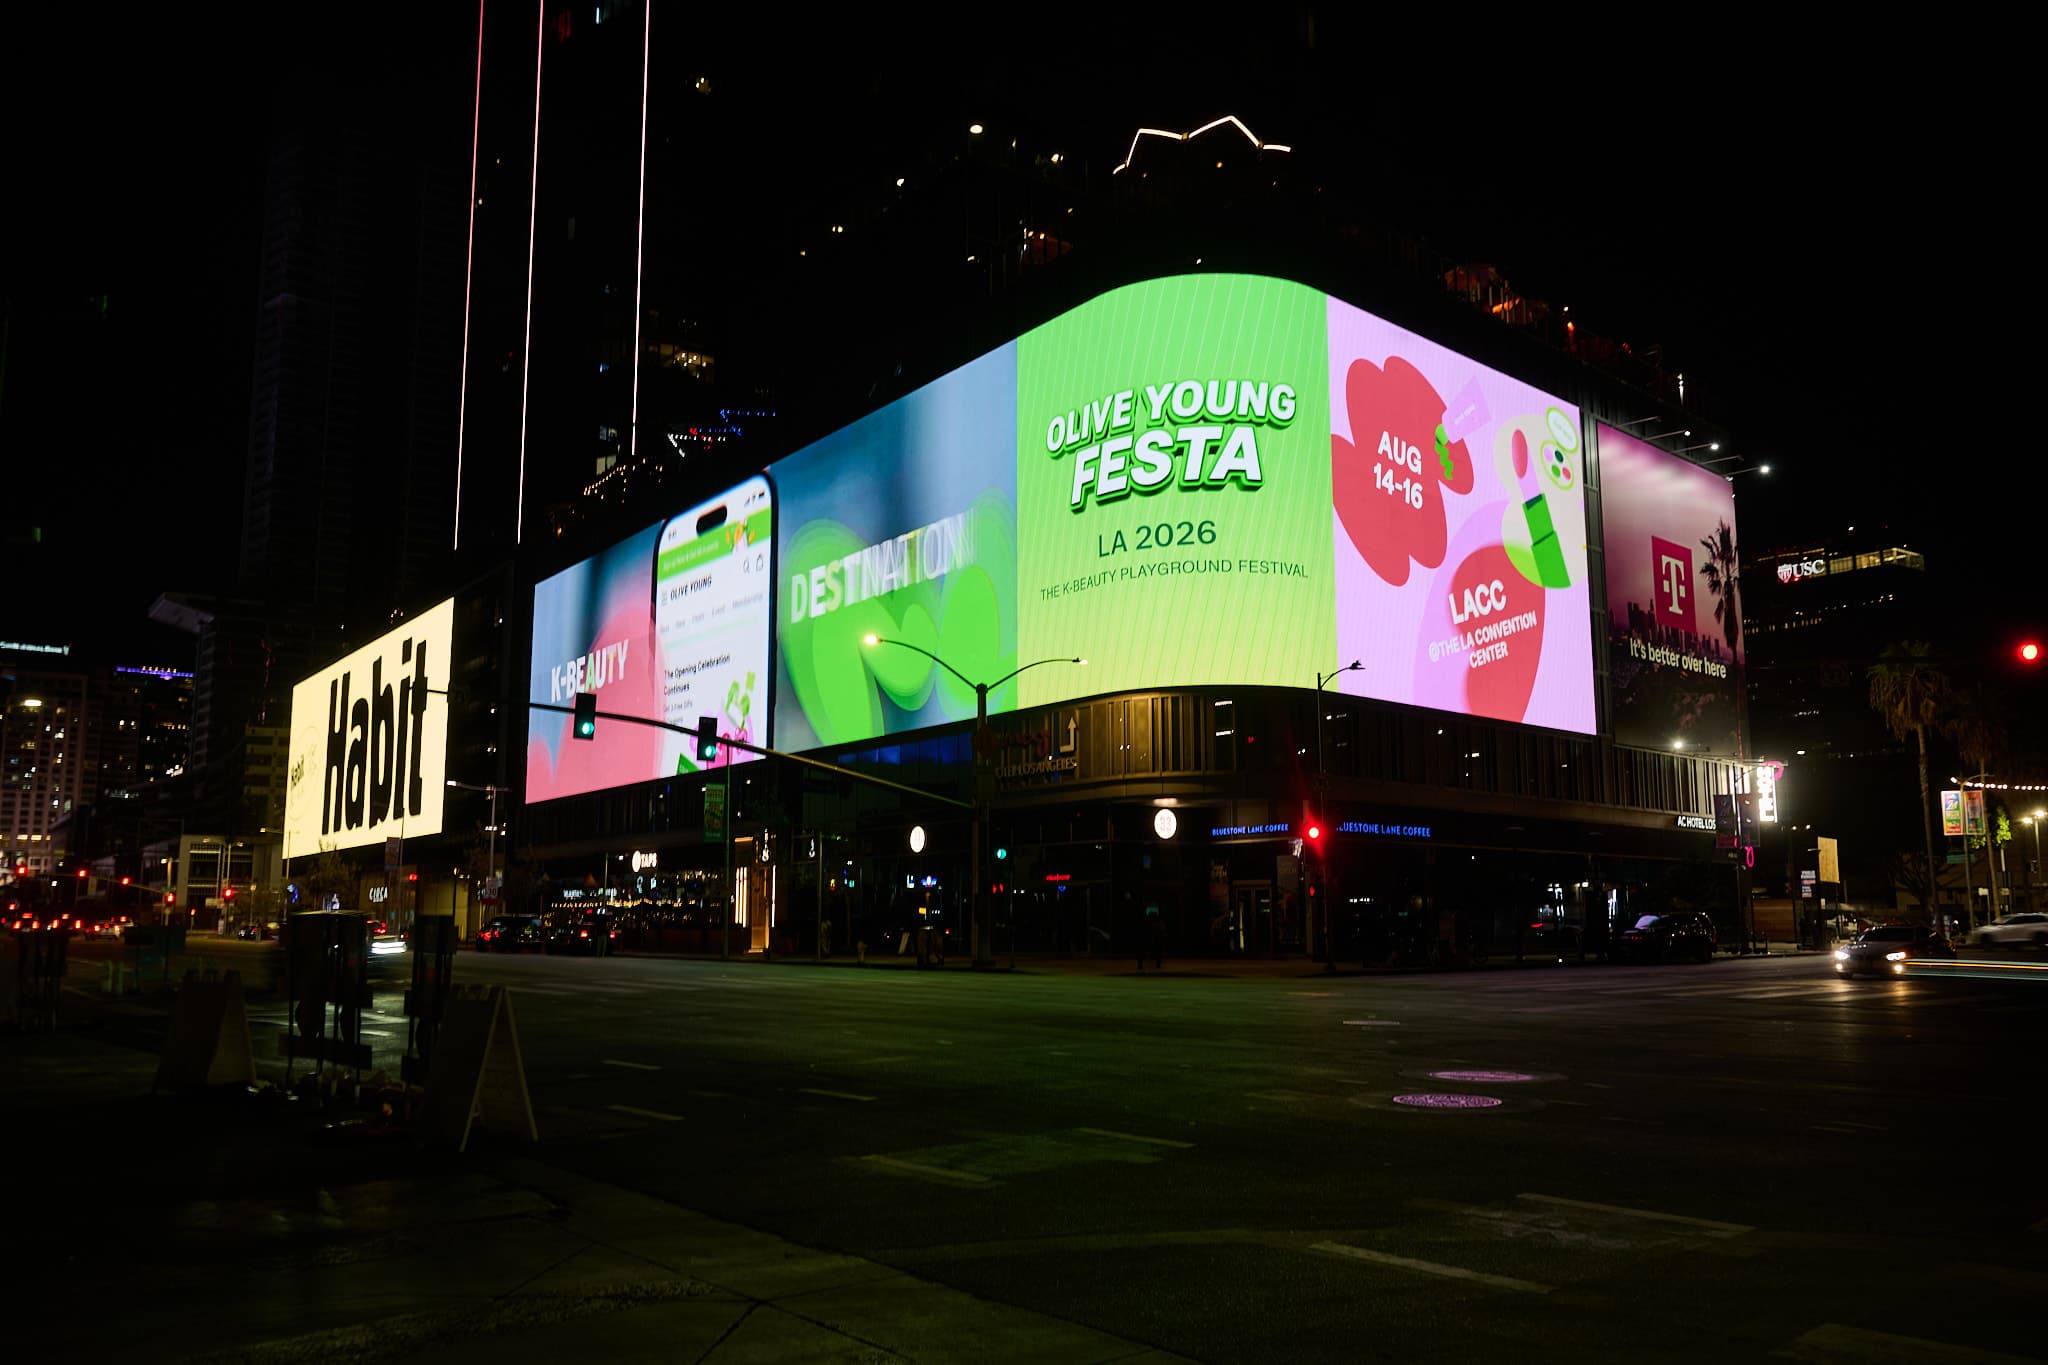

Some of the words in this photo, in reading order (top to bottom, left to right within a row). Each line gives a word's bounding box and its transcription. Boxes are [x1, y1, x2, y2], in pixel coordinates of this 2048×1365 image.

[1046, 389, 1135, 455] OLIVE
[1144, 379, 1297, 428] YOUNG
[1070, 425, 1263, 508] FESTA
[1377, 430, 1422, 475] AUG
[1373, 462, 1424, 509] 14-16
[1098, 530, 1128, 558] LA
[1135, 520, 1217, 551] 2026
[670, 584, 688, 600] OLIVE
[690, 575, 712, 592] YOUNG
[1040, 586, 1060, 601] THE
[1062, 569, 1117, 597] K-BEAUTY
[1120, 559, 1232, 581] PLAYGROUND
[1238, 559, 1309, 579] FESTIVAL
[1792, 559, 1825, 578] USC
[1448, 579, 1507, 625] LACC
[1428, 635, 1461, 663] @THE
[1460, 631, 1475, 651] LA
[1474, 610, 1538, 646] CONVENTION
[1469, 641, 1509, 669] CENTER
[551, 638, 629, 704] K-BEAUTY
[664, 669, 674, 680] The
[674, 664, 697, 679] Opening
[697, 653, 731, 673] Celebration
[1629, 637, 1647, 660] It's
[1647, 642, 1680, 668] better
[1681, 654, 1703, 674] over
[1704, 656, 1727, 679] here
[663, 682, 690, 696] Continues
[321, 636, 427, 836] Habit
[1212, 826, 1246, 837] BLUESTONE
[1247, 824, 1264, 834] LANE
[1264, 823, 1289, 833] COFFEE
[1335, 821, 1380, 835] LUESTONE
[1381, 823, 1402, 836] LANE
[1402, 826, 1431, 838] COFFEE
[1677, 815, 1687, 828] AC
[1686, 816, 1706, 830] HOTEL
[640, 852, 658, 869] TAPS
